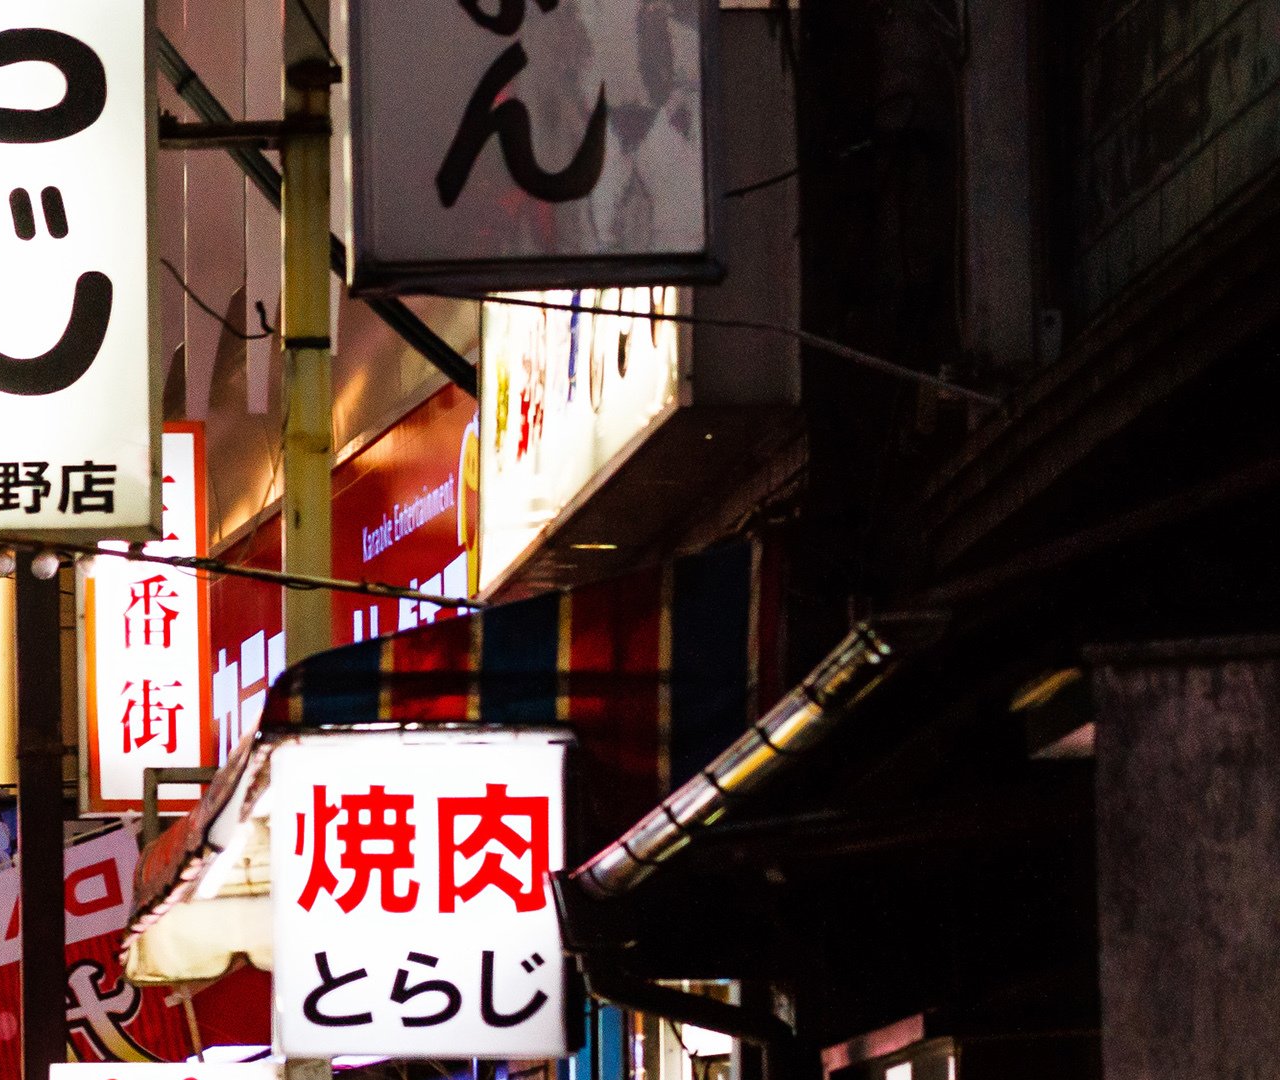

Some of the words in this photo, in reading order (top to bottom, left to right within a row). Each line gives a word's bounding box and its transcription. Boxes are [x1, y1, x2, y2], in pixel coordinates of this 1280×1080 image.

[436, 0, 605, 209] ん
[362, 513, 393, 563] Karaoke
[393, 471, 455, 542] Entertainment
[293, 782, 551, 915] 焼肉
[301, 948, 551, 1030] とらじ
